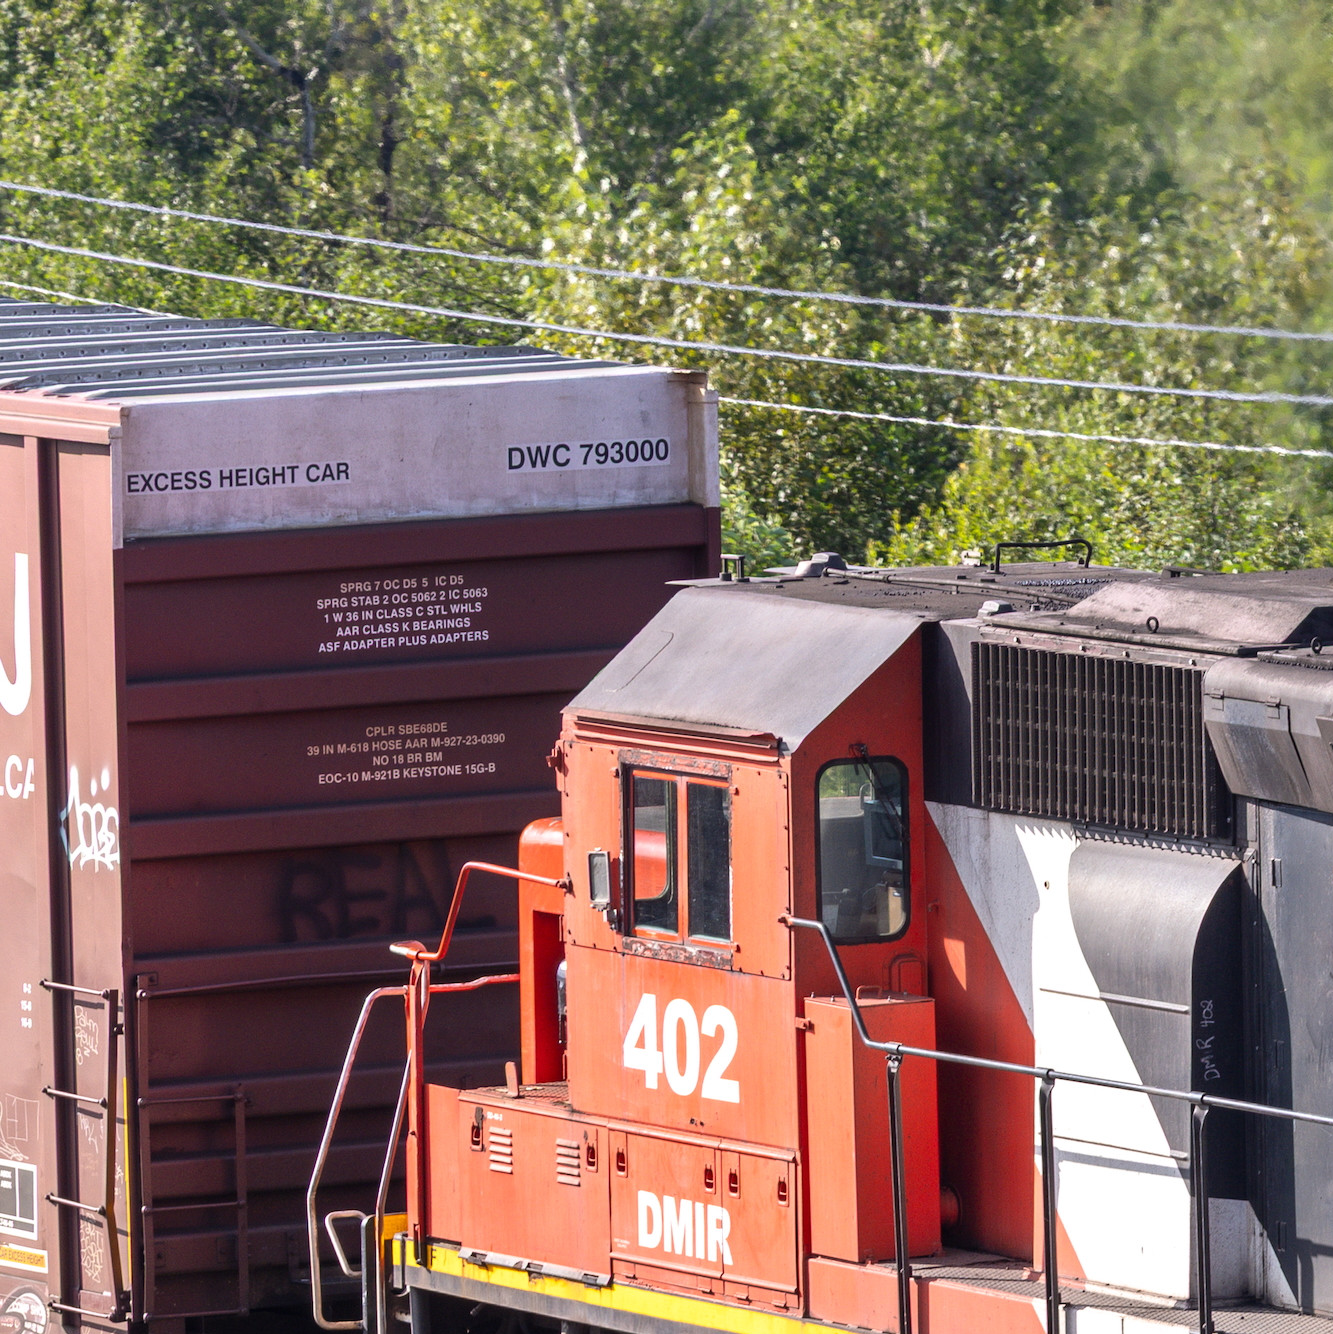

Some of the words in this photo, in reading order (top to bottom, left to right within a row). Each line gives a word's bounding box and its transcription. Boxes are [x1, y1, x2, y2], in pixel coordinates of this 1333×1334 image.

[508, 444, 570, 470] DWC
[579, 438, 669, 465] 793000
[127, 470, 212, 493] EXCESS
[219, 465, 299, 488] HEIGHT
[306, 462, 350, 483] CAR
[340, 582, 371, 593] SPRG
[374, 581, 381, 590] 7
[383, 579, 400, 590] OC
[403, 578, 417, 589] D5
[422, 577, 428, 587] 5
[435, 576, 447, 586] IC
[449, 574, 464, 585] D5
[317, 597, 348, 609] SPRG
[351, 595, 380, 607] STAB
[383, 594, 389, 605] 2
[391, 593, 409, 604] OC
[411, 591, 437, 603] 5062
[439, 590, 446, 600] 2
[449, 589, 460, 599] IC
[462, 587, 488, 598] 5063
[324, 613, 329, 623] 1
[332, 612, 343, 623] W
[346, 611, 359, 622] 36
[362, 610, 373, 620] IN
[376, 607, 413, 619] CLASS
[415, 606, 424, 617] C
[427, 604, 447, 616] STL
[450, 602, 482, 614] WHLS
[336, 625, 360, 637] AAR
[362, 623, 399, 635] CLASS
[402, 621, 410, 632] K
[413, 617, 471, 631] BEARINGS
[318, 642, 340, 653] ASF
[343, 637, 396, 651] ADAPTER
[398, 635, 427, 647] PLUS
[430, 630, 489, 645] ADAPTERS
[366, 726, 395, 738] CPLR
[398, 722, 448, 736] SBE68DE
[307, 745, 320, 756] 39
[322, 744, 334, 755] IN
[337, 742, 369, 755] M-618
[372, 740, 402, 752] HOSE
[405, 737, 428, 749] AAR
[372, 755, 389, 766] NO
[392, 753, 404, 765] 18
[407, 752, 423, 764] BR
[425, 751, 443, 763] BM
[318, 771, 359, 784] EOC-10
[361, 768, 400, 782] M-921B
[403, 764, 462, 779] KEYSTONE
[465, 762, 496, 775] 15G-B
[1200, 1000, 1215, 1028] 402
[623, 992, 740, 1104] 402
[1195, 1035, 1220, 1081] DMIR
[637, 1189, 734, 1266] DMIR
